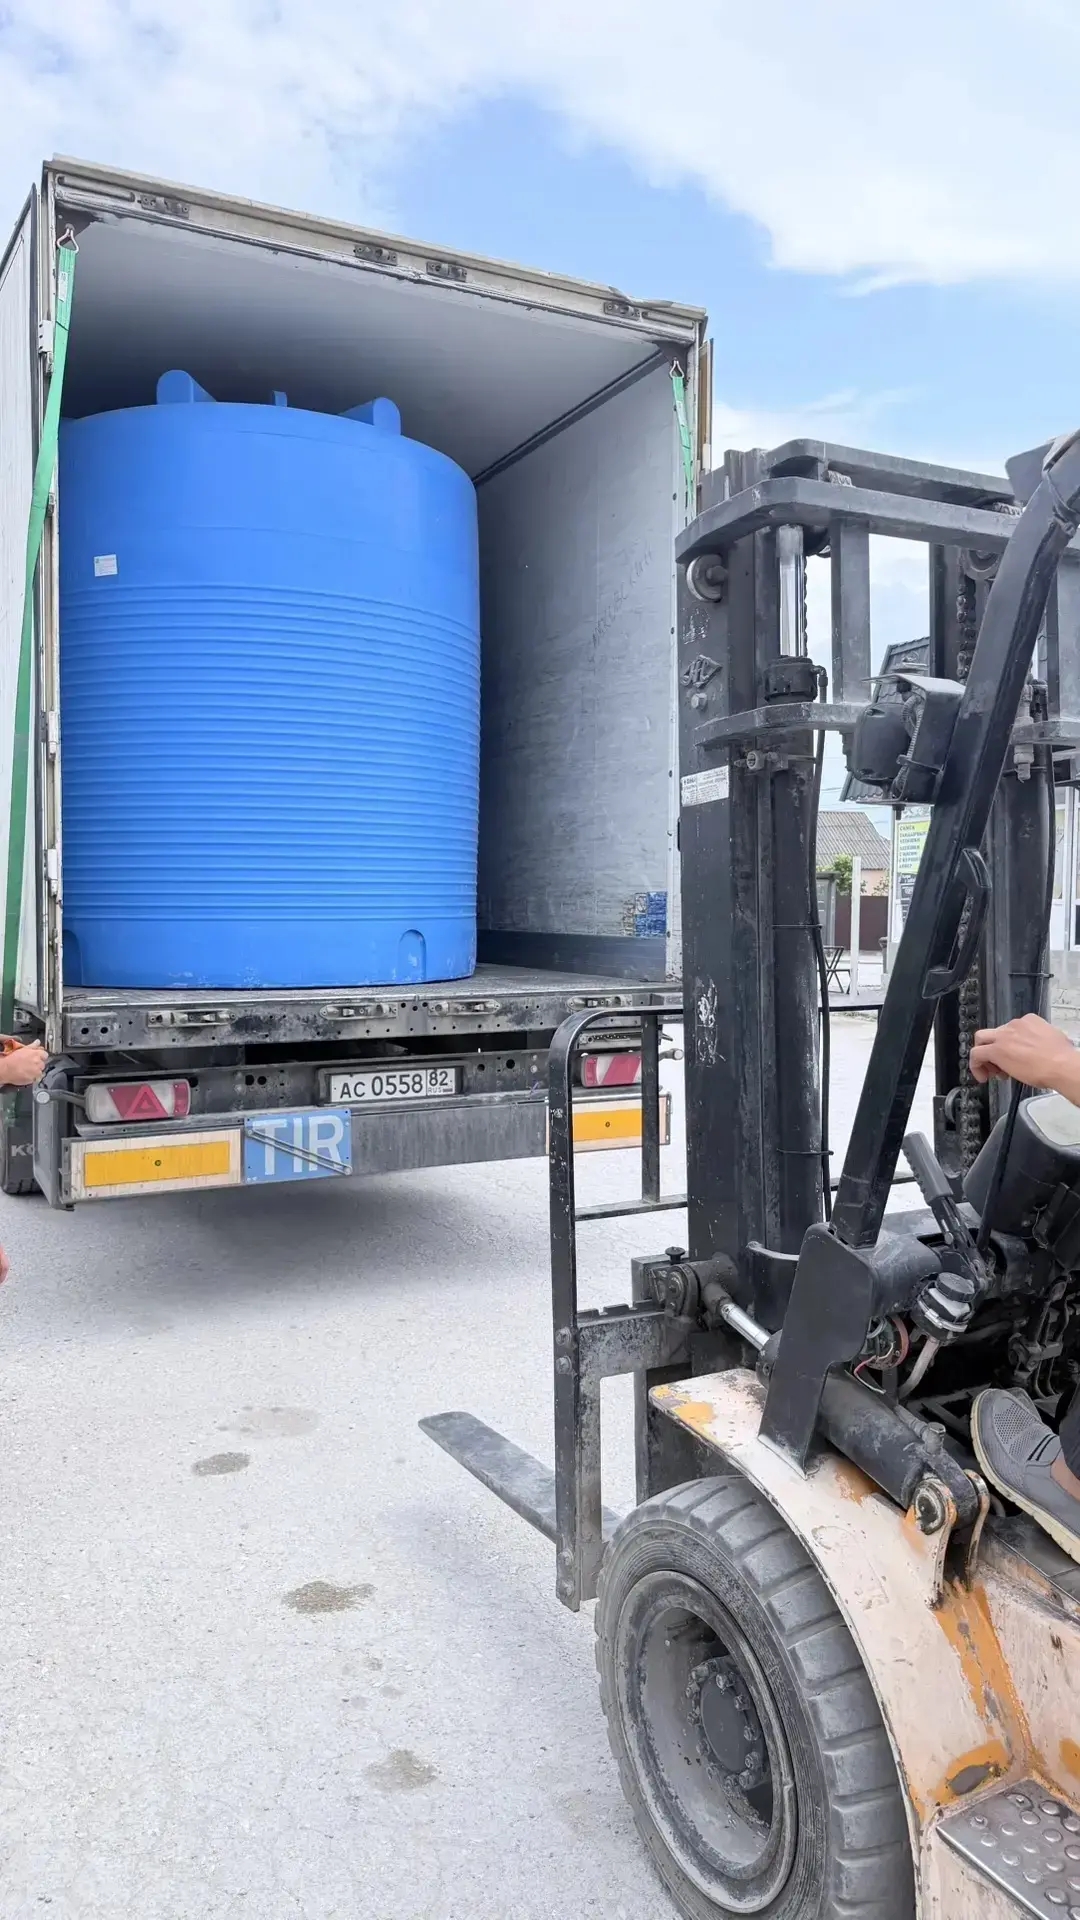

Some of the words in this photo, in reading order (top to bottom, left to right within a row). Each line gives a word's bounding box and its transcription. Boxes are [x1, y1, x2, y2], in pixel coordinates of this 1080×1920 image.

[340, 1081, 366, 1099] AC
[371, 1073, 423, 1097] 0558
[428, 1070, 449, 1087] 82
[252, 1115, 344, 1176] TIR
